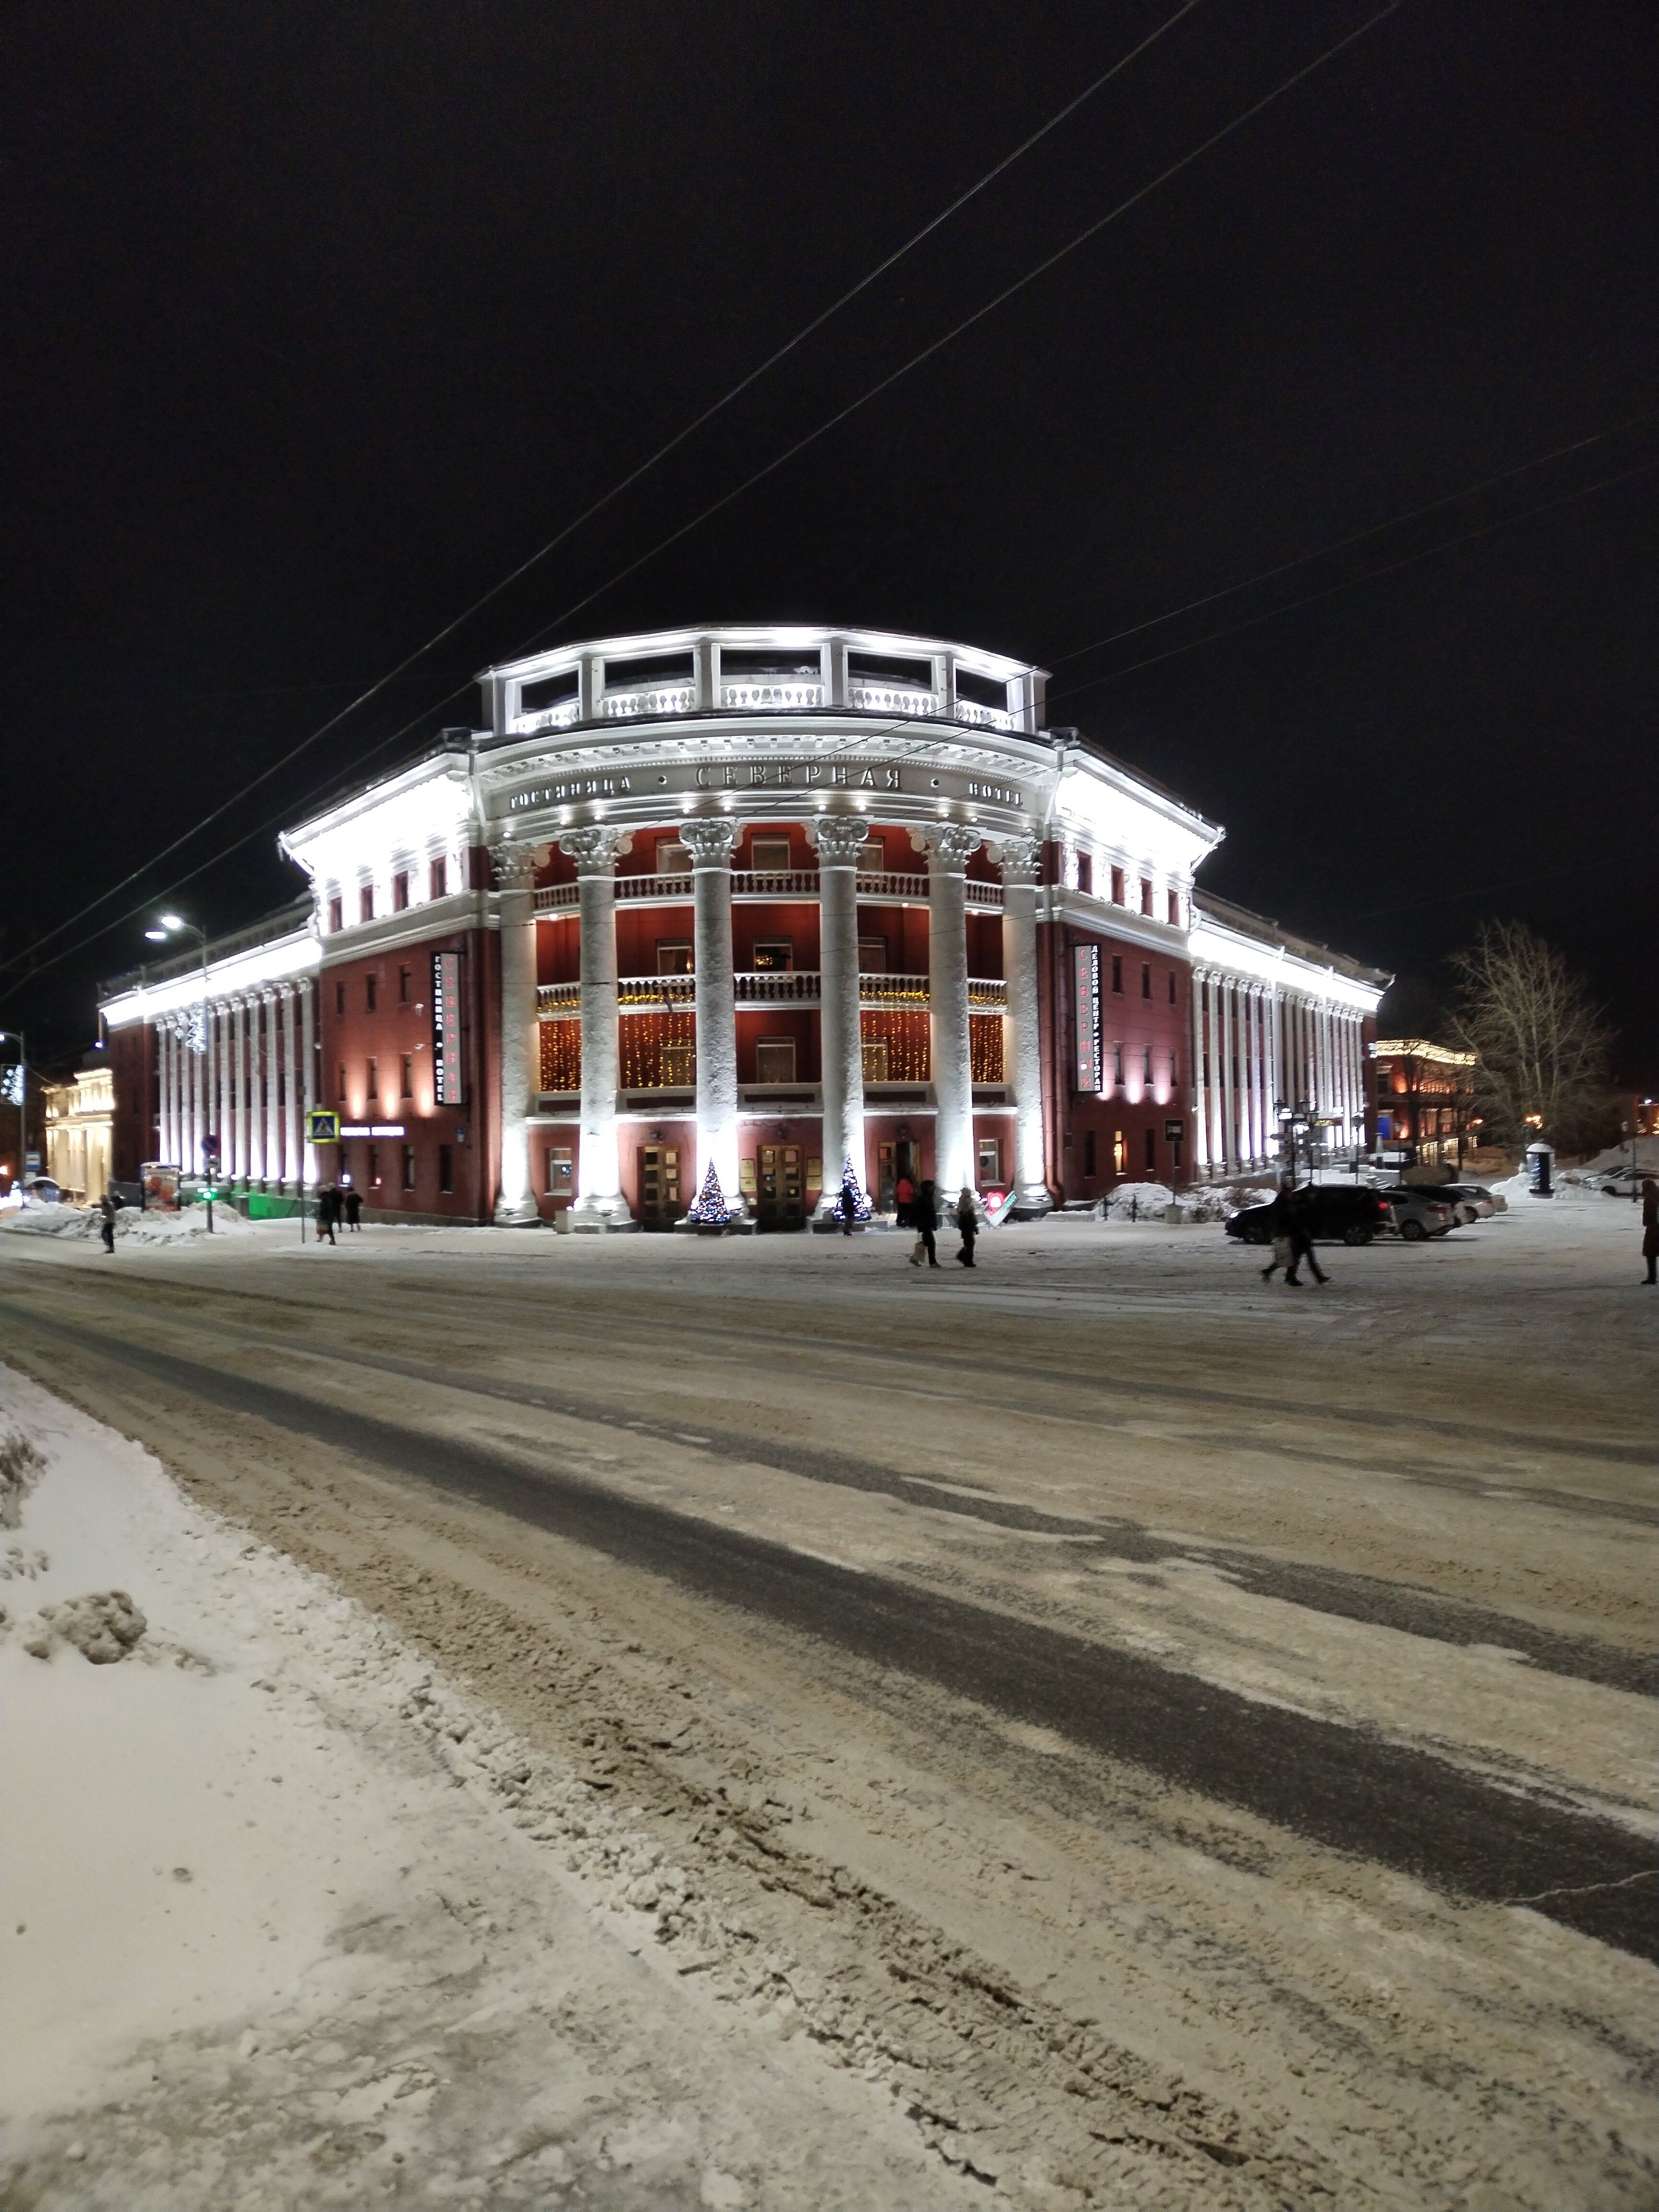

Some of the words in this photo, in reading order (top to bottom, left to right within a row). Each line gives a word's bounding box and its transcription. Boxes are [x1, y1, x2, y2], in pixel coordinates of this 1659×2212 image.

[511, 777, 630, 809] ГОСТИНИЦА
[695, 766, 902, 790] СЕВЕРНАЯ
[445, 957, 458, 1102] СЕВЕРНАЯ
